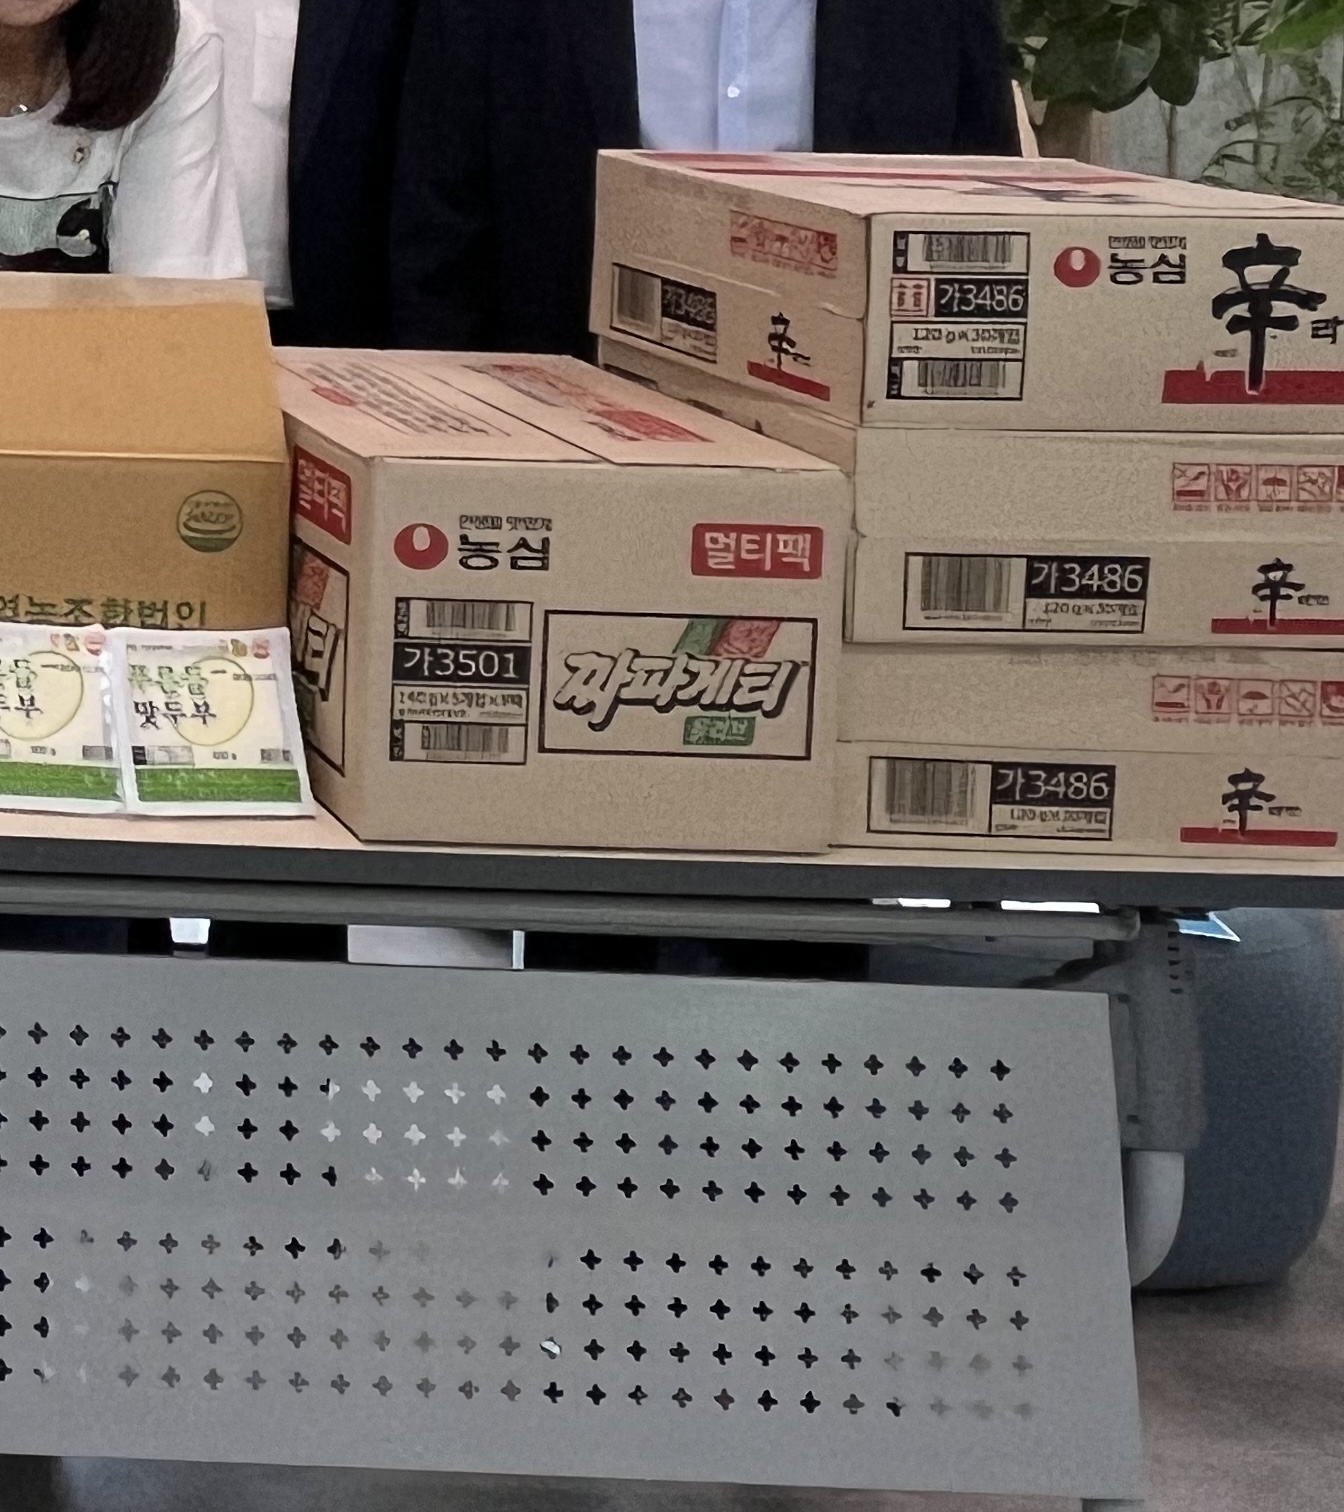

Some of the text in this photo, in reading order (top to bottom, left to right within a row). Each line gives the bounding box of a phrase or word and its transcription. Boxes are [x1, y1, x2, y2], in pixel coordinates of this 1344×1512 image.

[1108, 253, 1186, 286] 농심
[1212, 233, 1327, 393] 辛
[457, 534, 550, 571] 농심
[705, 532, 811, 572] 멀티팩
[1032, 562, 1144, 594] 가3486
[1252, 557, 1305, 628] 辛
[404, 647, 520, 678] 가3501
[553, 648, 801, 732] 짜파게티
[997, 768, 1109, 801] 가3486
[1222, 767, 1276, 837] 辛
